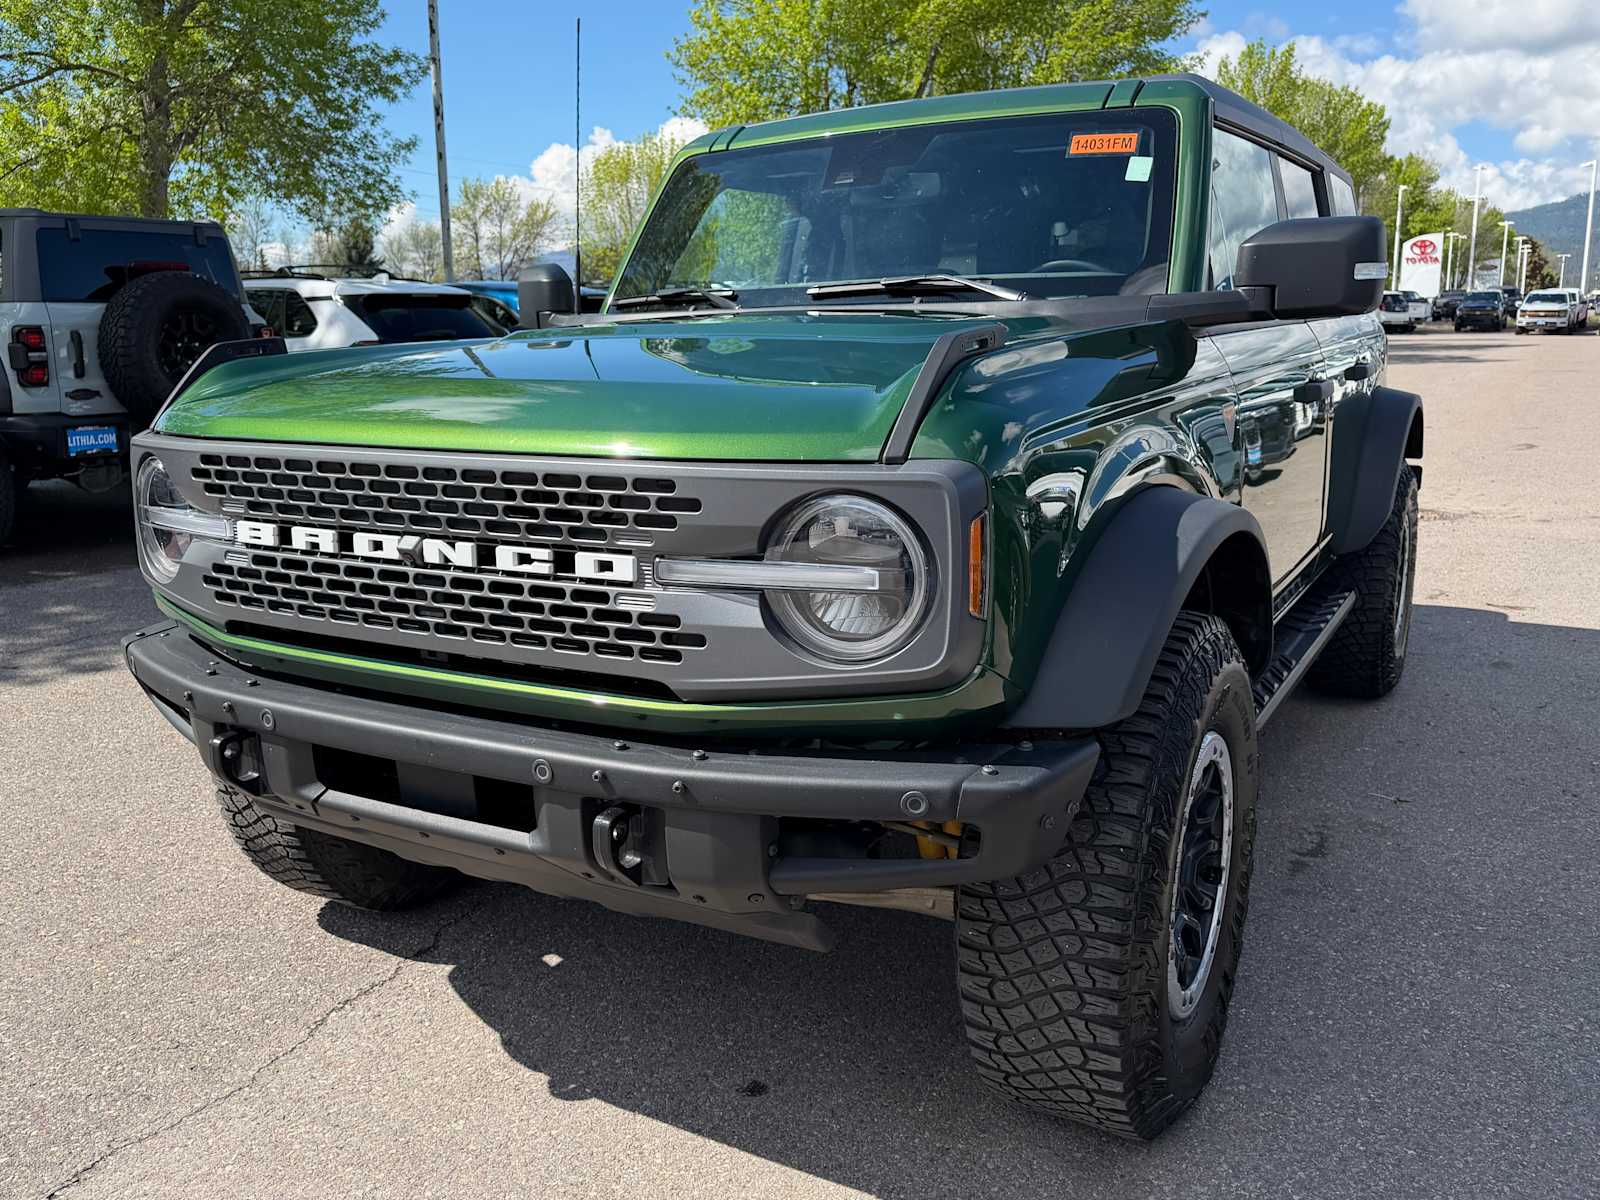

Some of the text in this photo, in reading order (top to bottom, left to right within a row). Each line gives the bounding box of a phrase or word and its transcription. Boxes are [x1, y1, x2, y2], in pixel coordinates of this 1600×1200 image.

[1074, 137, 1133, 151] 14031FM
[1405, 256, 1440, 264] TOYOTA
[67, 432, 117, 447] LITHIA.COM
[236, 520, 638, 583] BRONCO
